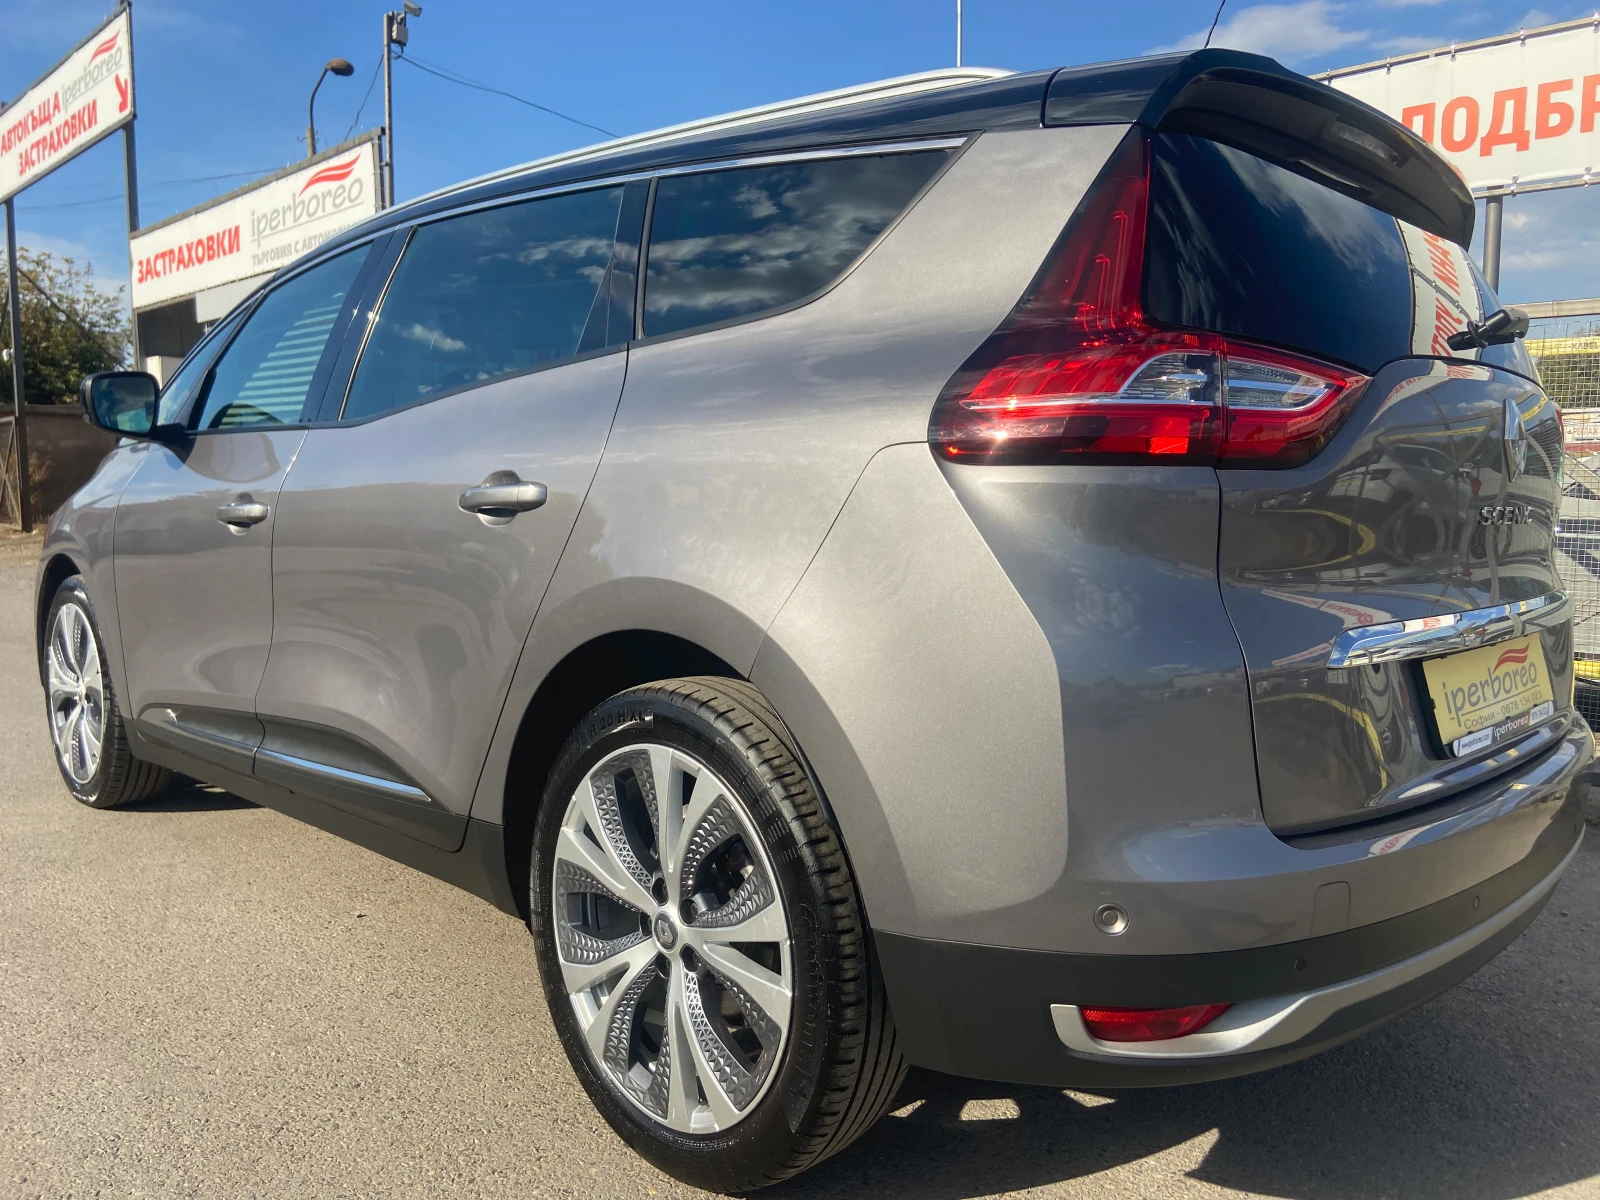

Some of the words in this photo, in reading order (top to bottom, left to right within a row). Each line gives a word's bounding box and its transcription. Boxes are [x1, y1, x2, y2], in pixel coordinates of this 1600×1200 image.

[62, 46, 123, 115] iperboreo
[0, 90, 61, 157] АВТОКЪЩА
[18, 98, 98, 177] ЗАСТРАХОВКИ
[251, 176, 363, 248] iperboreo
[138, 224, 241, 284] ЗАСТРАХОВКИ
[252, 243, 293, 267] ТЪРГОВИЯ
[601, 713, 614, 730] 20
[1442, 661, 1538, 727] iperboreo
[1464, 711, 1495, 730] София
[1501, 700, 1519, 715] 0878
[1493, 714, 1529, 741] iperboreo
